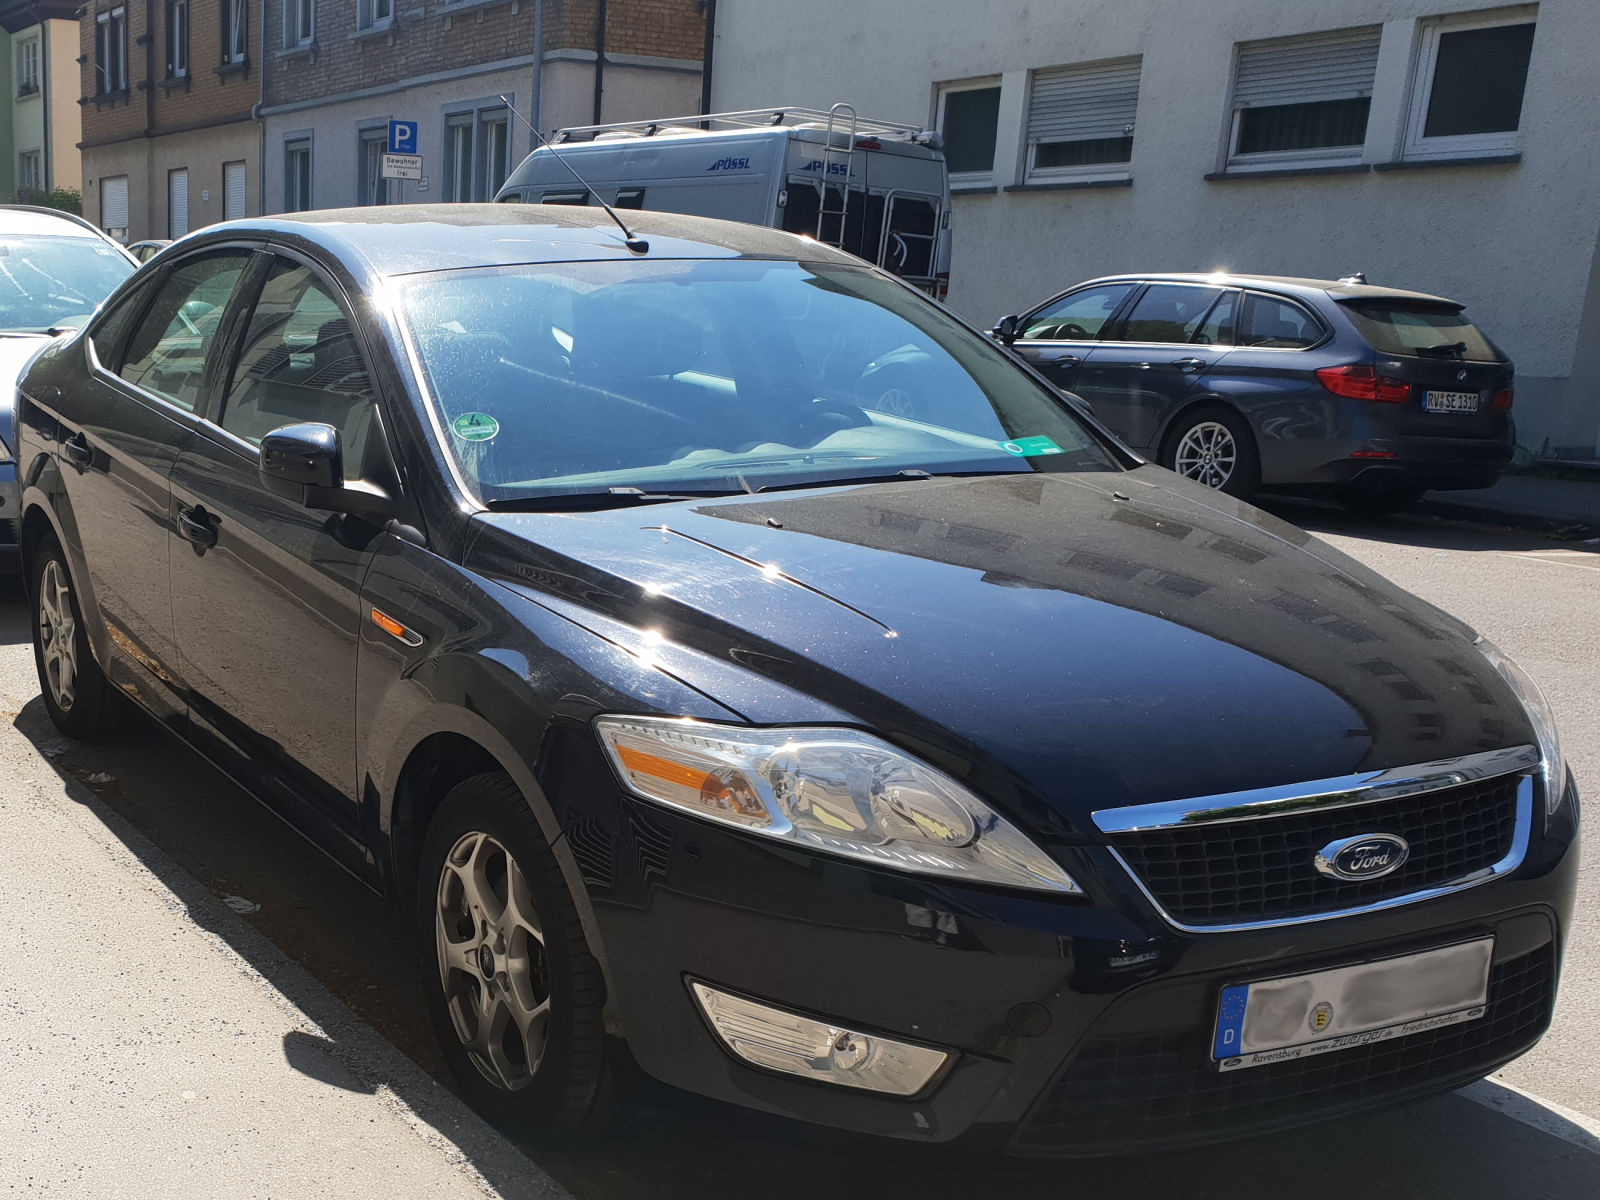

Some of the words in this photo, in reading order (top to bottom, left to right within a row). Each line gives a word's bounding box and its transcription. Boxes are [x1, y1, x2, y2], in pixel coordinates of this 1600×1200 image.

[395, 124, 411, 149] P
[386, 156, 418, 166] Bewohner
[716, 157, 750, 171] PÖSSL
[397, 169, 408, 177] frei
[1428, 393, 1440, 408] RV
[1446, 393, 1457, 409] SE
[1458, 394, 1478, 410] 1310
[469, 414, 481, 426] 4
[1350, 844, 1391, 871] Ford
[1223, 1028, 1235, 1045] D
[1252, 1048, 1302, 1064] Ravensburg
[1401, 1014, 1459, 1034] Friedrichshafen
